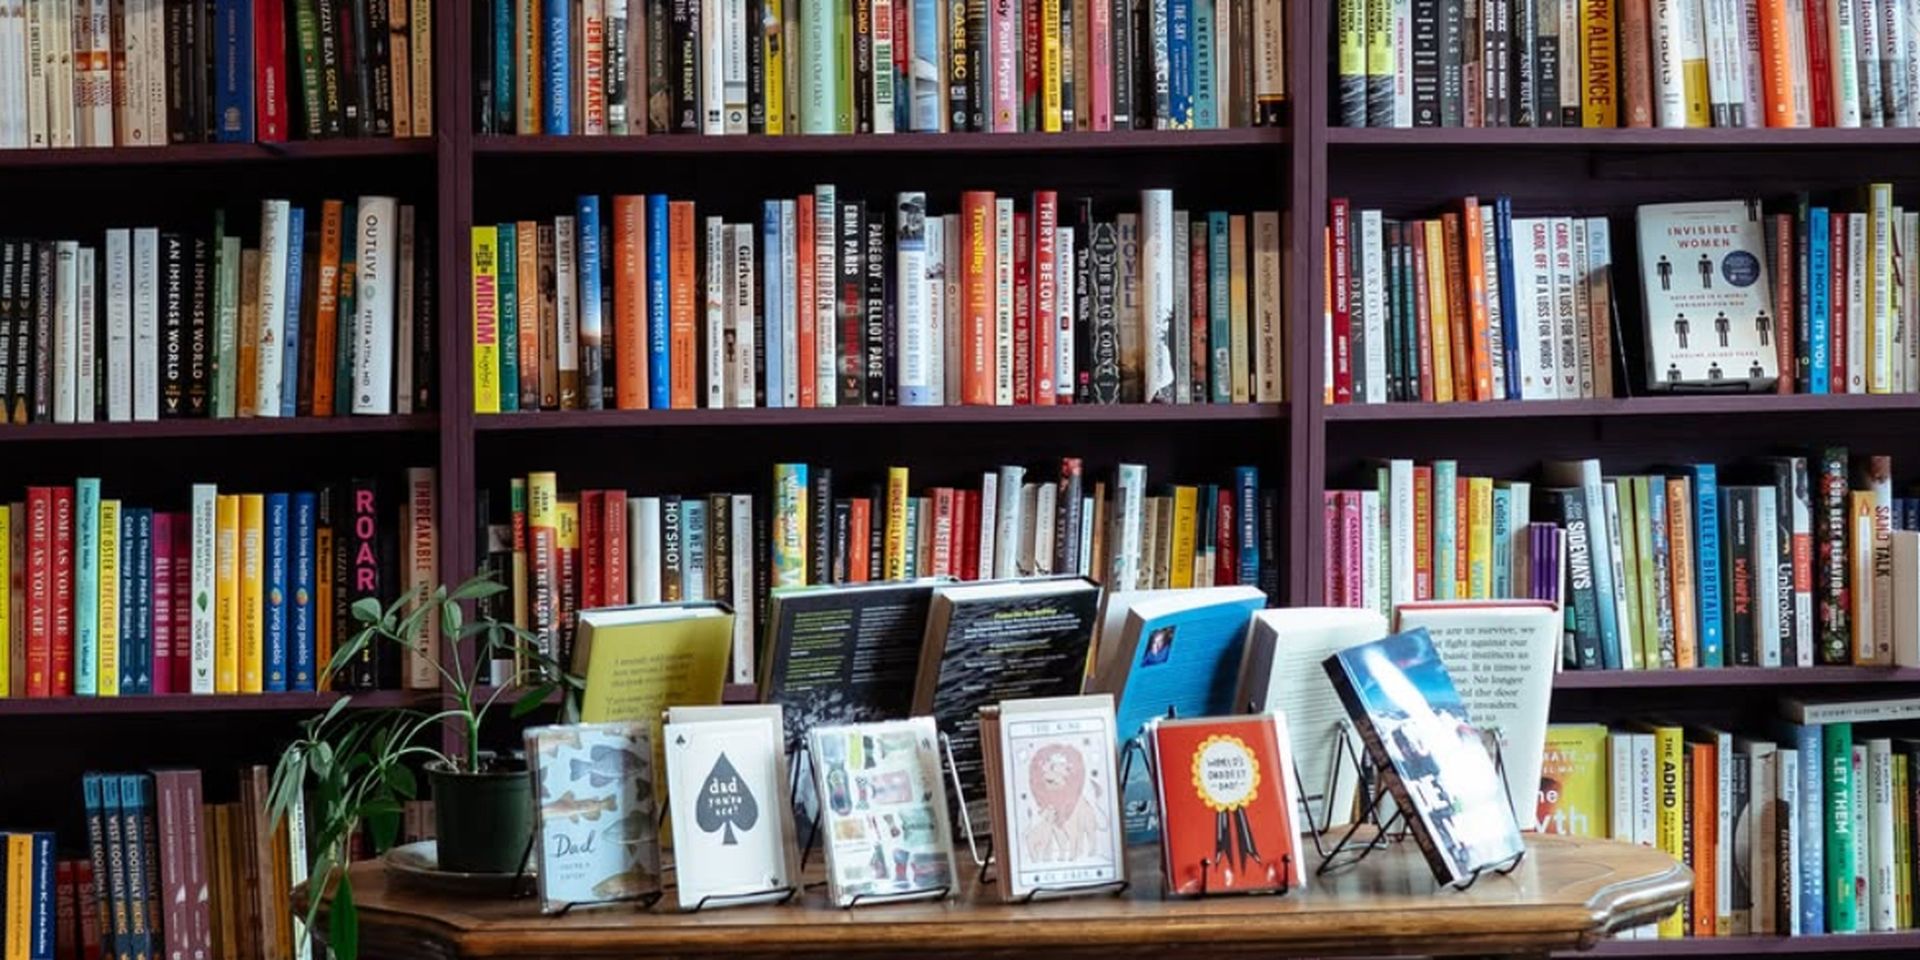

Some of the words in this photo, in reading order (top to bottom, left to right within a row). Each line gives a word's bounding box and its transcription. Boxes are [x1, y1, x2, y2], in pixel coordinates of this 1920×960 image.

[954, 3, 966, 50] CASE
[1448, 6, 1459, 54] GIRLS
[954, 54, 967, 79] BC
[1588, 26, 1612, 106] ALLIANCE
[364, 214, 379, 281] OUTLIVE
[1040, 201, 1054, 254] THIRTY
[1667, 224, 1740, 237] INVISIBLE
[1677, 239, 1731, 249] WOMEN
[168, 240, 180, 259] AN
[868, 223, 882, 279] PAGEBOY
[1100, 254, 1113, 281] THE
[168, 263, 180, 326] IMMENSE
[193, 263, 205, 325] IMMENSE
[1040, 261, 1054, 313] BELOW
[1100, 285, 1113, 327] BLACK
[476, 274, 496, 344] MIRIAM
[868, 298, 882, 343] ELLIOT
[167, 329, 179, 380] WORLD
[192, 329, 204, 379] WORLD
[868, 347, 882, 378] PAGE
[1101, 331, 1113, 376] COUNT
[1814, 343, 1826, 369] YOU
[33, 498, 44, 542] COME
[57, 497, 70, 541] COME
[356, 489, 376, 592] ROAR
[414, 480, 432, 572] UNBREAKABLE
[665, 502, 680, 573] HOTSHOT
[1875, 505, 1890, 541] SAND
[33, 546, 44, 567] AS
[57, 545, 69, 566] AS
[536, 530, 549, 564] WHERE
[1567, 520, 1591, 590] SIDEWAYS
[1875, 545, 1891, 580] TALK
[33, 570, 44, 601] YOU
[57, 569, 69, 600] YOU
[537, 567, 549, 586] THE
[33, 606, 44, 637] ARE
[57, 604, 69, 636] ARE
[536, 587, 550, 624] FALCON
[1778, 562, 1795, 638] Unbroken
[1665, 737, 1674, 758] THE
[709, 776, 739, 795] dad
[1663, 761, 1676, 808] ADHD
[1833, 756, 1847, 784] LET
[1834, 789, 1849, 834] THEM
[553, 831, 597, 858] Dad
